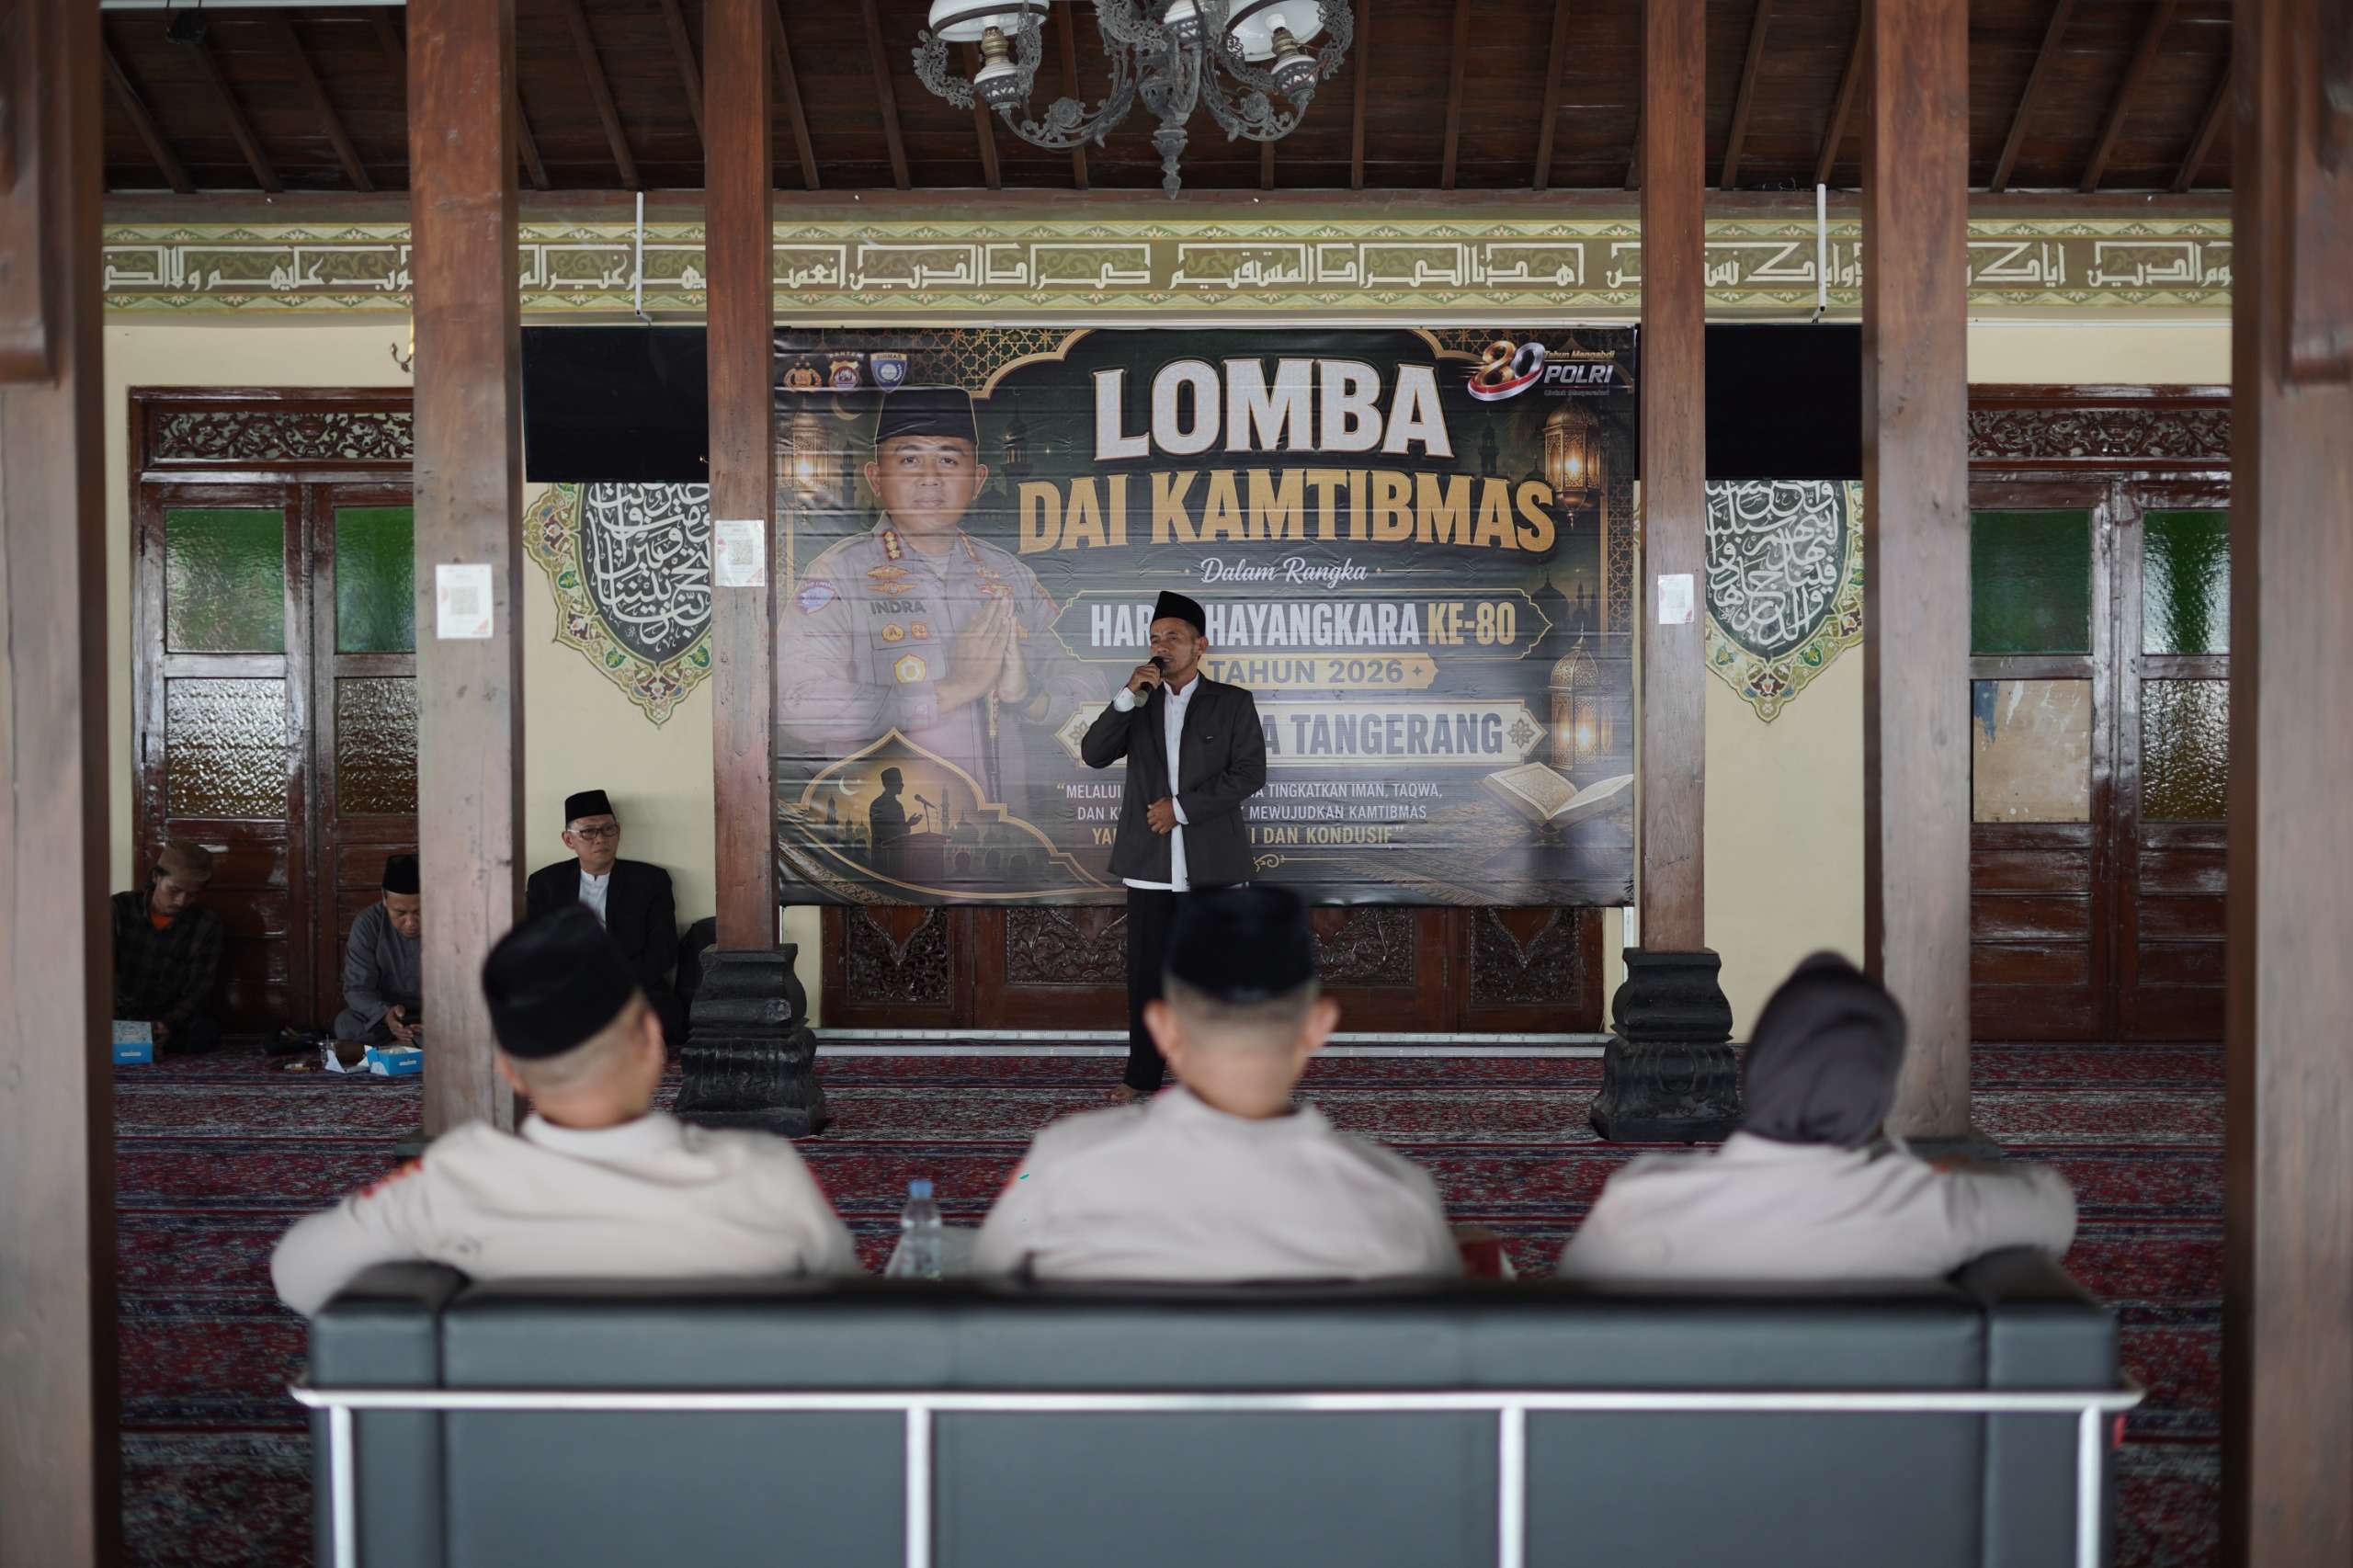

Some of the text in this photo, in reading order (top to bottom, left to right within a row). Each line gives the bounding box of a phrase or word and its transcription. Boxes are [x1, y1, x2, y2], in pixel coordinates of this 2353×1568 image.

[1543, 364, 1614, 384] POLRI
[1093, 357, 1455, 461] LOMBA
[1018, 467, 1556, 554] DAI KAMTIBMAS
[1200, 557, 1369, 589] Dalam Rangka
[870, 599, 926, 615] INDRA
[1090, 600, 1517, 647] HAR HAYANGKARA KE-80
[1207, 659, 1404, 684] TAHUN 2026
[1290, 712, 1504, 756] TANGERANG
[1267, 783, 1347, 798] TINGKATKAN
[1393, 783, 1443, 799] TAQWA,
[1077, 804, 1104, 820] DAN
[1249, 804, 1427, 820] MEWUJUDKAN KAMTIBMAS
[1263, 827, 1299, 845] DAN
